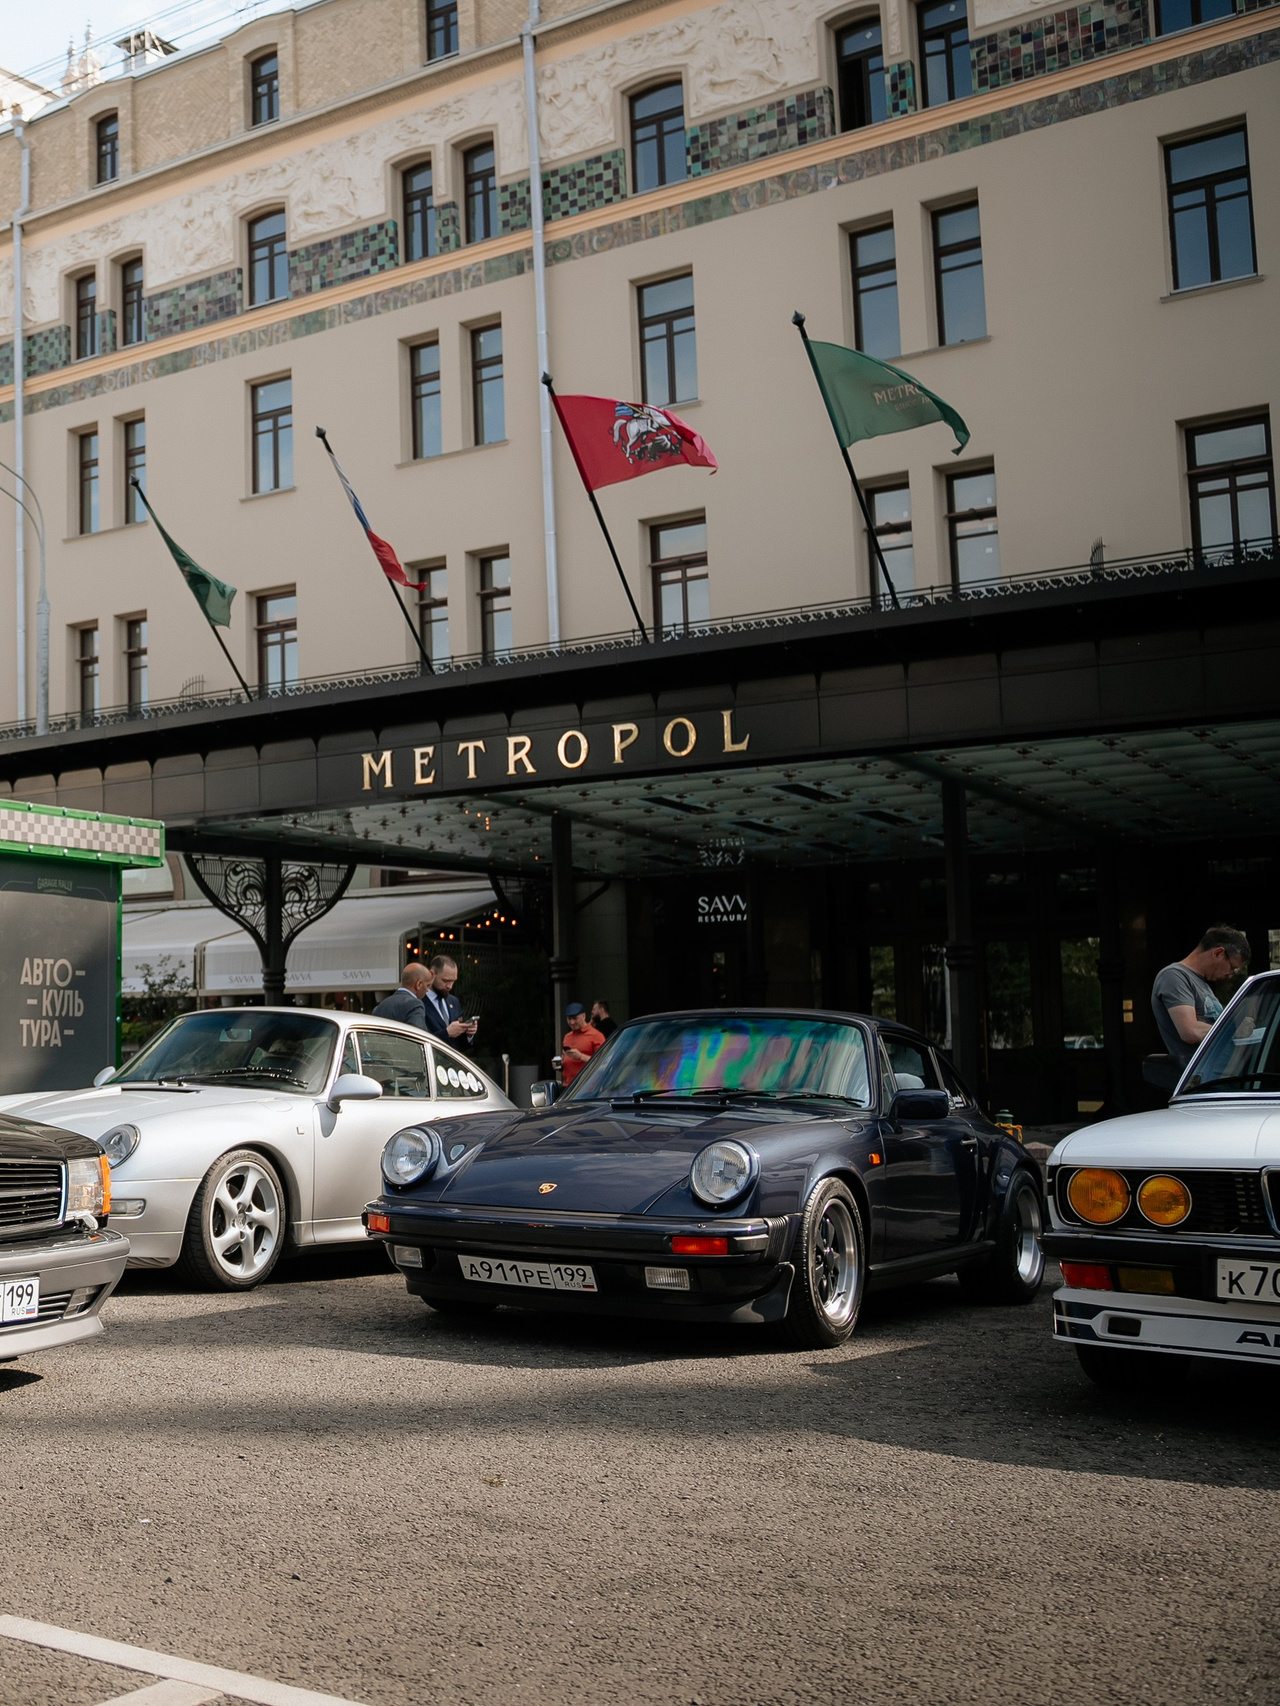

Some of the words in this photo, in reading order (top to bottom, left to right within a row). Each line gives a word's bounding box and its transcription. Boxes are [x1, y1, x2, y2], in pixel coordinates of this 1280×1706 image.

[361, 709, 750, 790] METROPOL
[37, 878, 57, 889] GARAGE
[58, 879, 73, 892] RALLY
[228, 975, 255, 984] SAVVA
[342, 970, 371, 980] SAVVA
[554, 1266, 587, 1282] 199
[6, 1283, 34, 1307] 199
[11, 1307, 26, 1316] RUS
